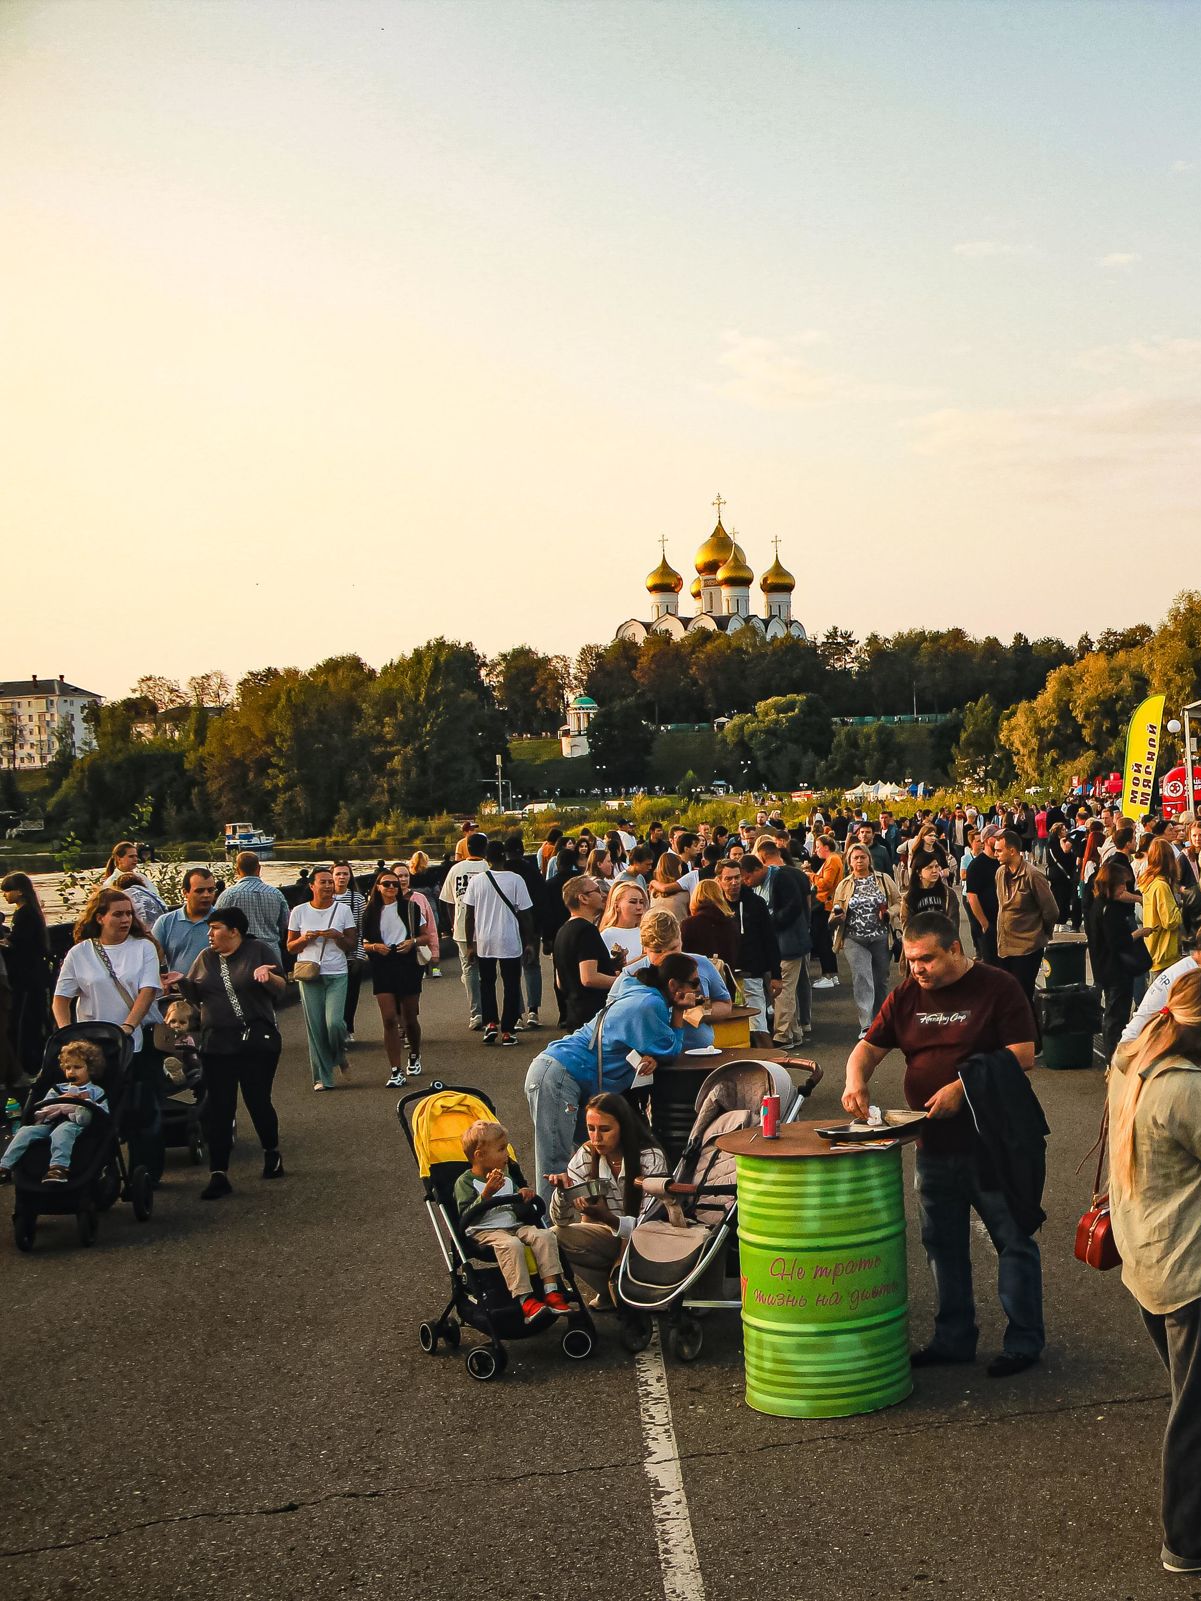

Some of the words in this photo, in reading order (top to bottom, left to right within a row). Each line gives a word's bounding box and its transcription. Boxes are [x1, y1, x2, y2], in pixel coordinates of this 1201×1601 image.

[1139, 723, 1158, 806] МЯСНОЙ
[1129, 762, 1143, 804] МОЙ
[769, 1257, 806, 1281] Не
[815, 1291, 843, 1307] на
